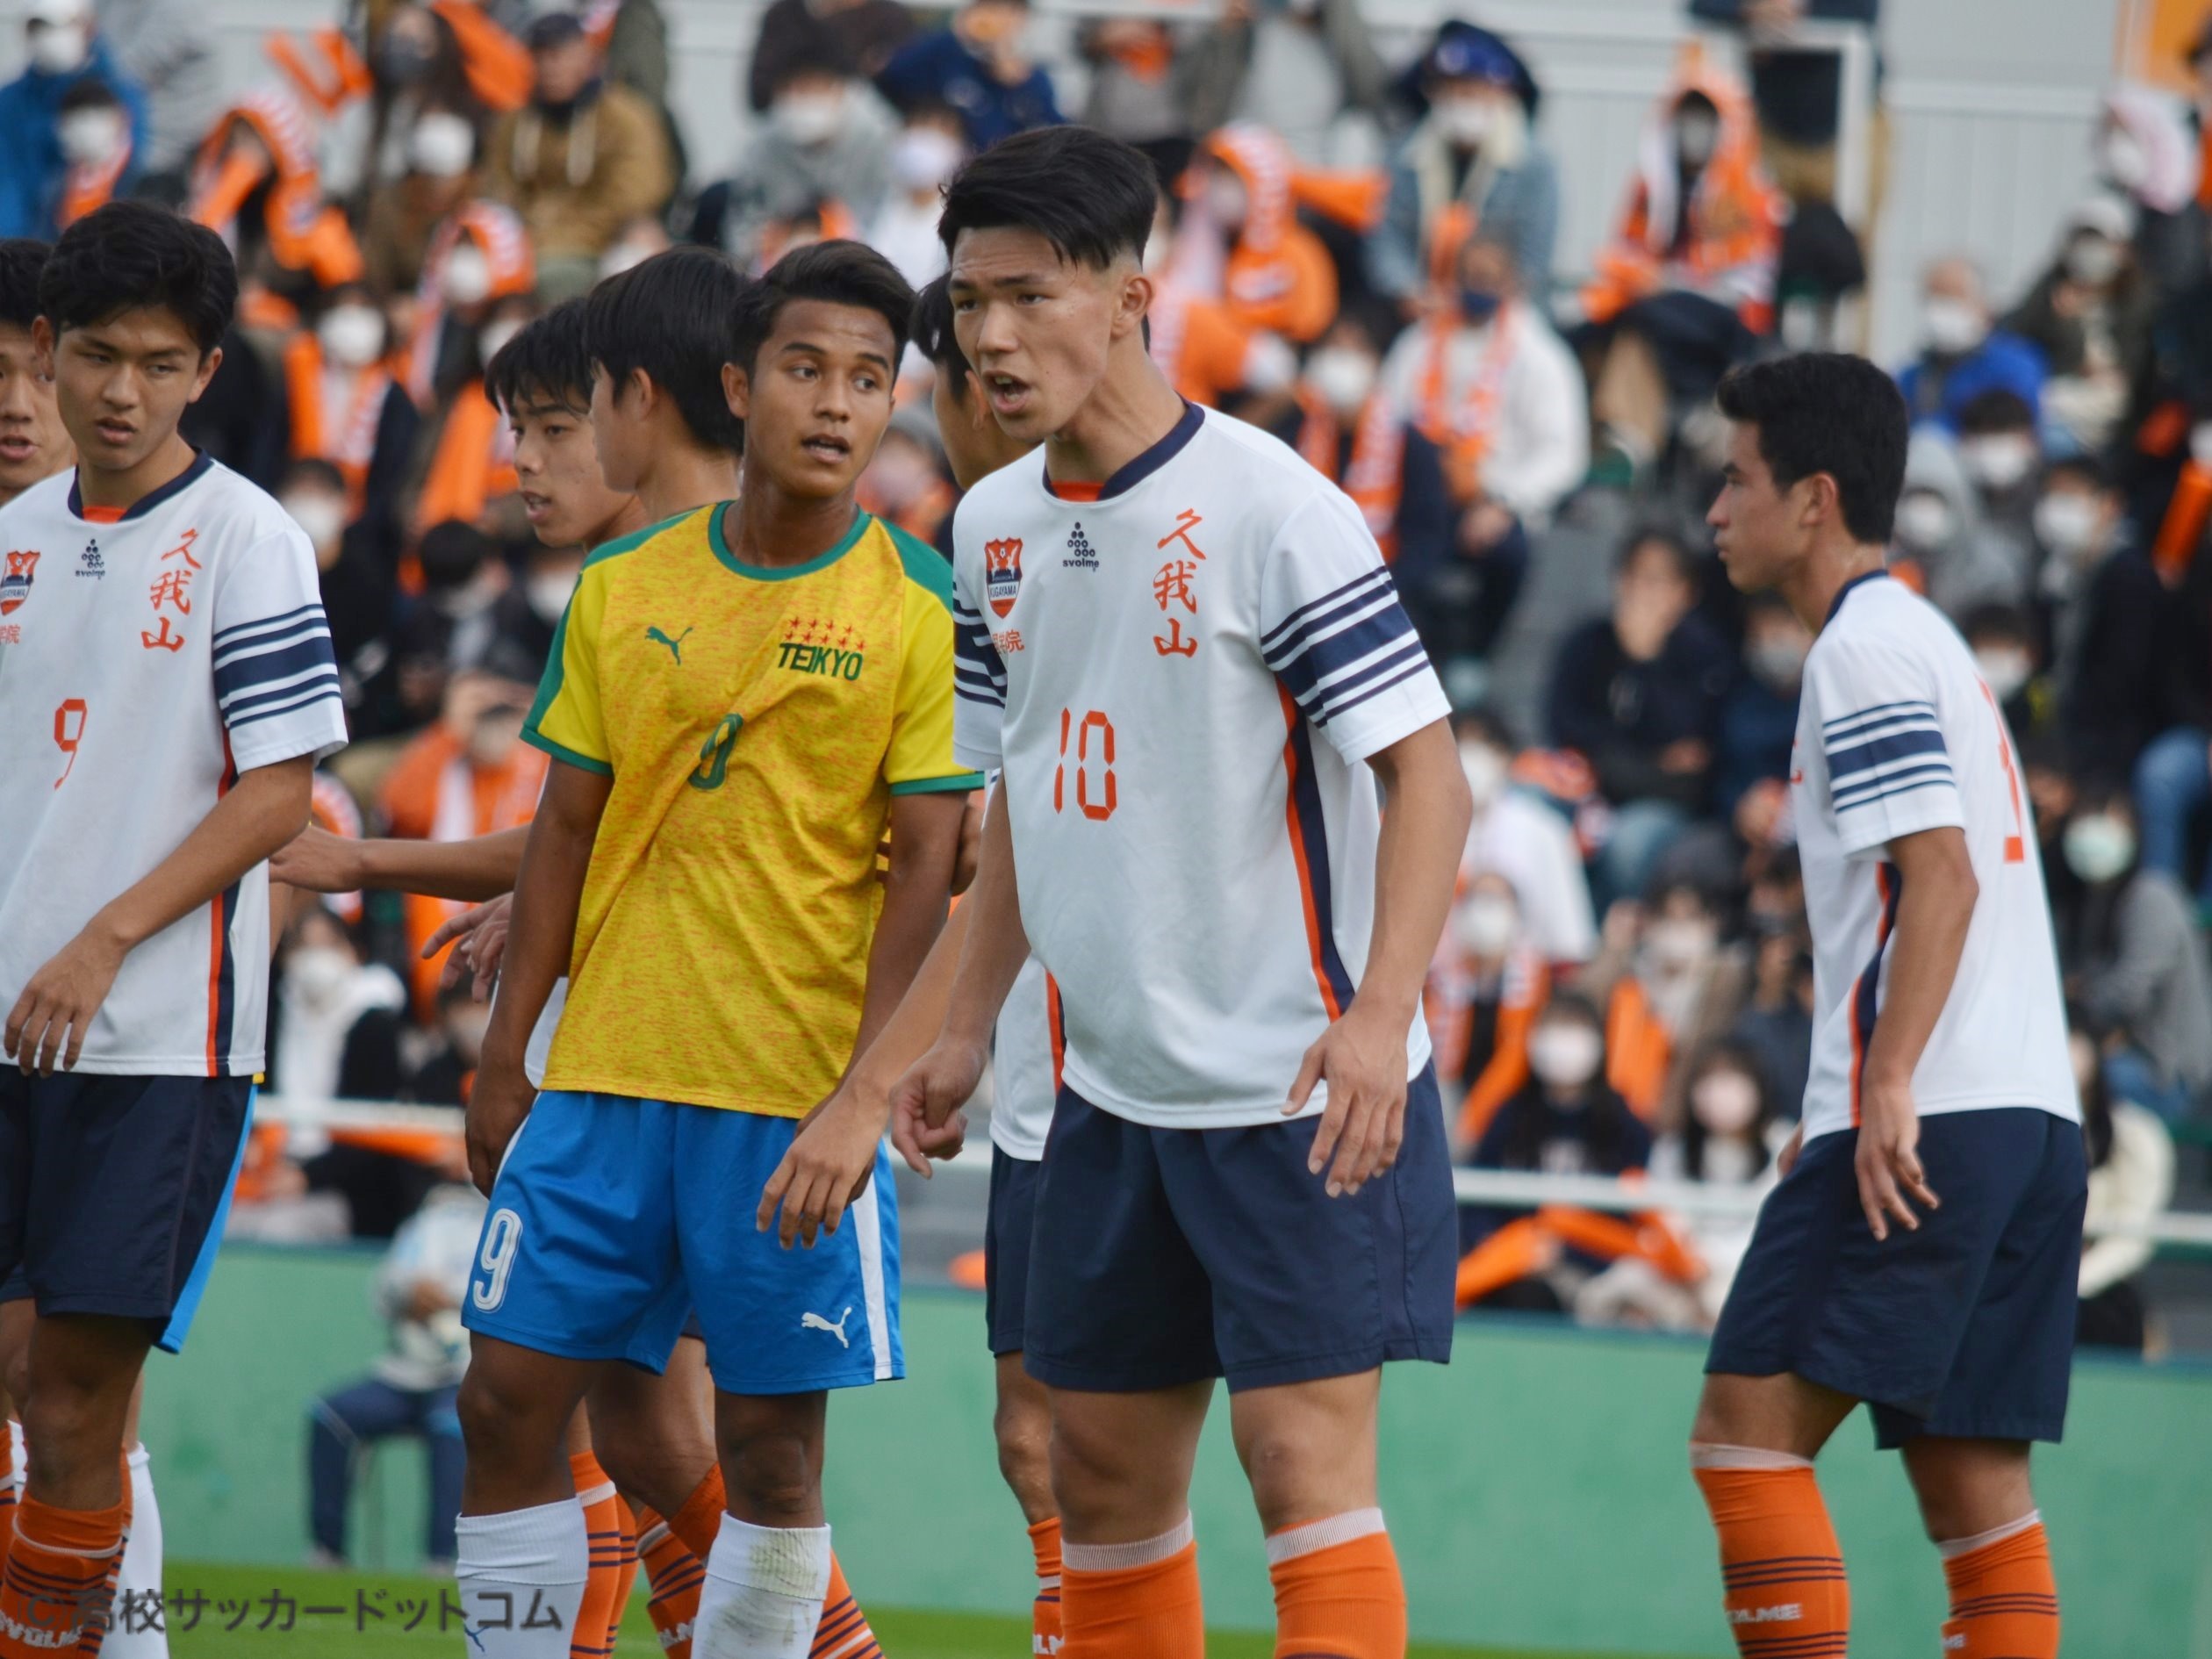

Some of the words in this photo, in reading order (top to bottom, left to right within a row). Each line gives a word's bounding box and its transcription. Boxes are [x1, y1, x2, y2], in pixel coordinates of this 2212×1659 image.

[140, 528, 203, 654] 久我山
[1062, 558, 1100, 570] svolme
[1153, 507, 1207, 658] 久我山
[778, 642, 865, 682] TEIKYO
[54, 698, 88, 791] 9
[1052, 707, 1117, 822] 10
[471, 1208, 523, 1313] 9
